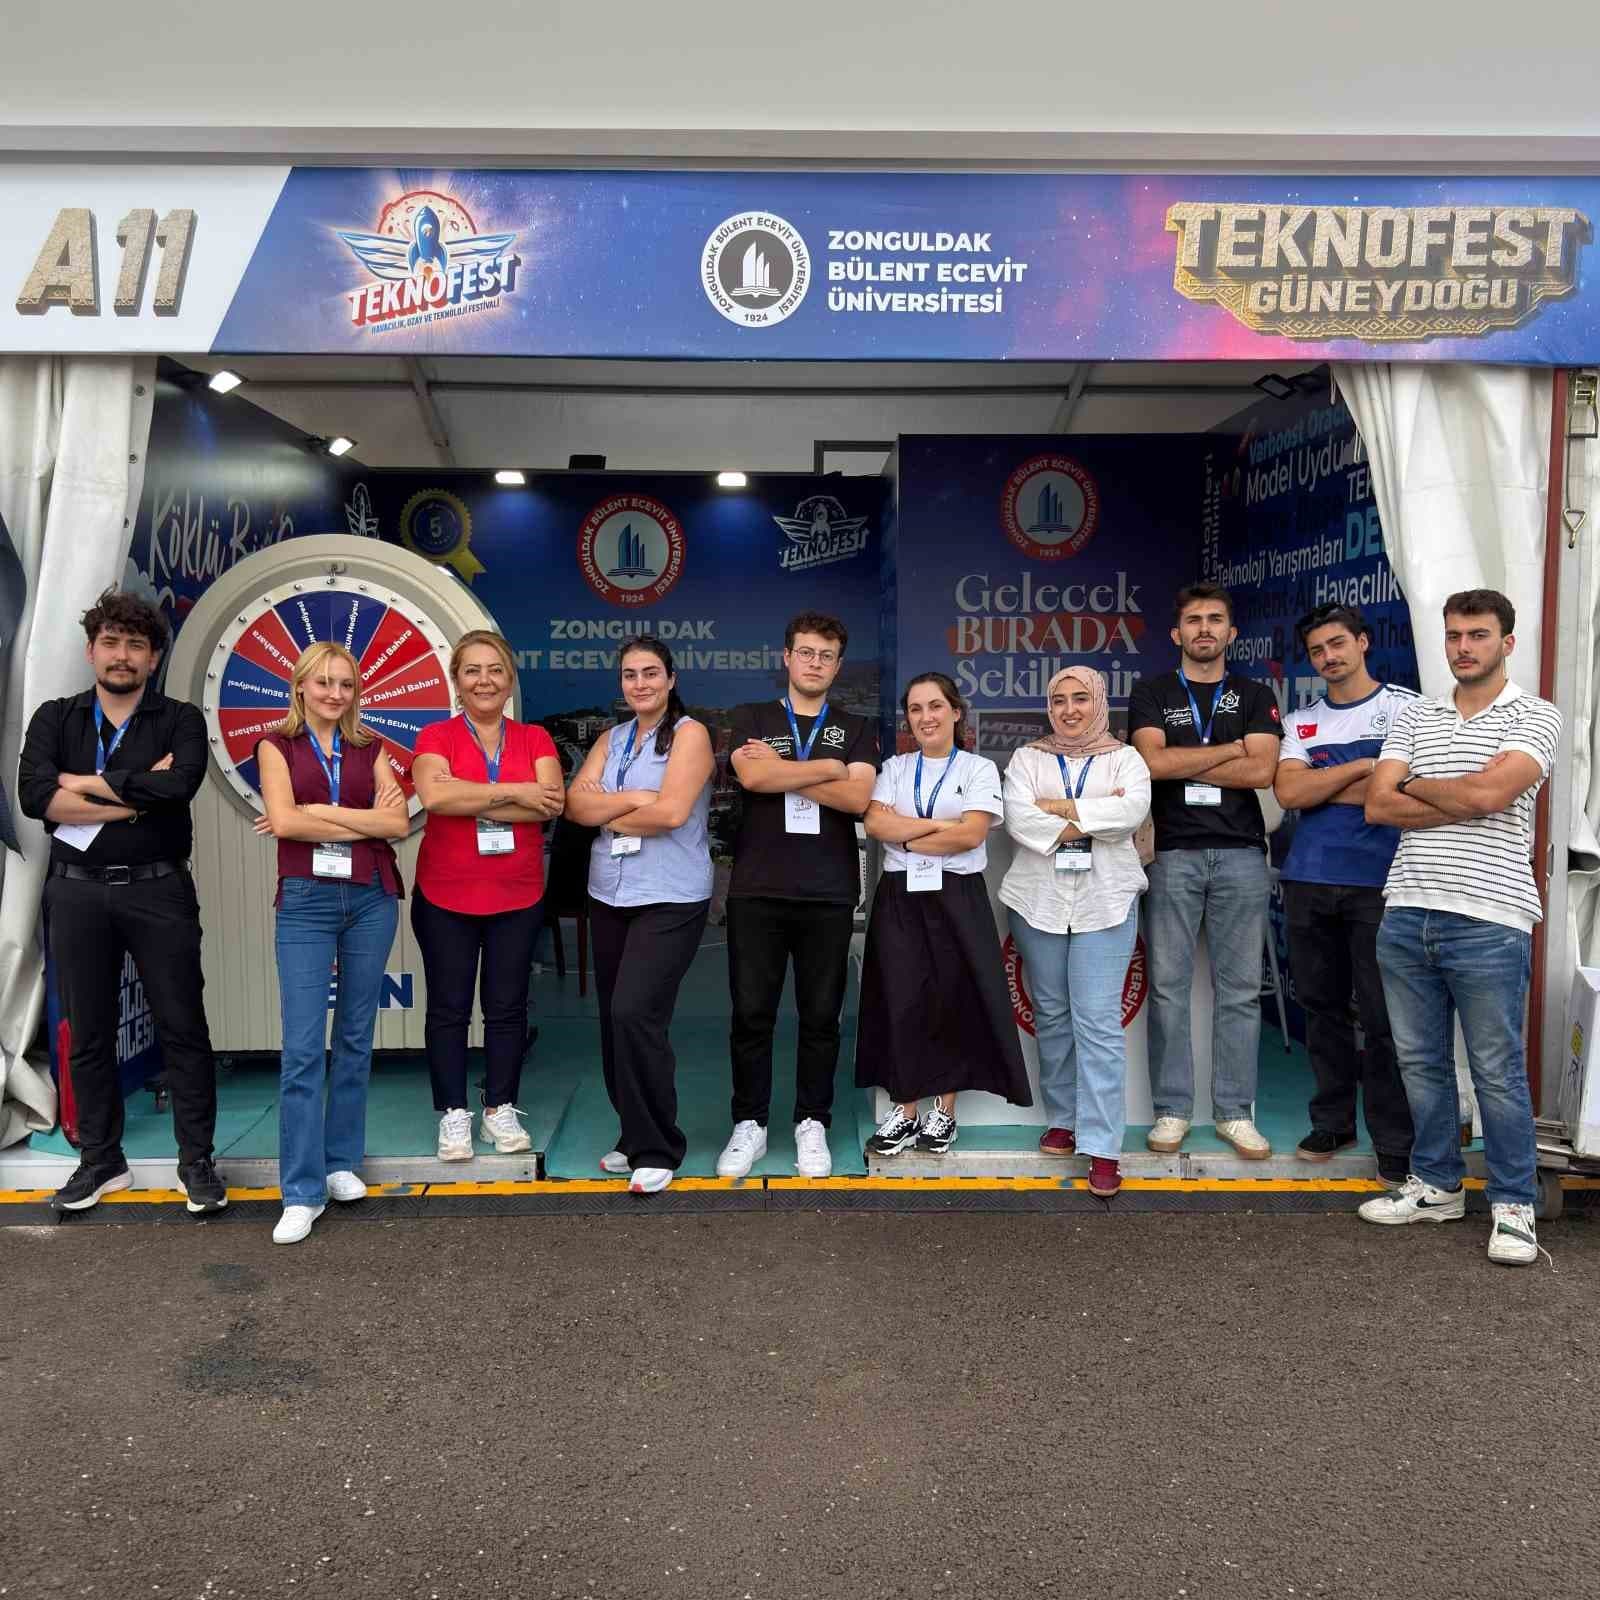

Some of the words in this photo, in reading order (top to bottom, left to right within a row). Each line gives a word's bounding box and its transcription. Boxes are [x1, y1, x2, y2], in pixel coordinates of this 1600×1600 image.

[715, 217, 753, 244] BÜLENT
[756, 217, 794, 241] ECEVİT
[828, 230, 993, 253] ZONGULDAK
[1170, 206, 1579, 271] TEKNOFEST
[15, 207, 198, 317] A11
[706, 244, 734, 313] ZONGULDAK
[778, 240, 807, 316] ÜNİVERSİTESİ
[828, 256, 930, 282] BÜLENT
[936, 256, 1028, 283] ECEVİT
[348, 253, 522, 326] TEKNOFEST
[828, 286, 1003, 313] ÜNİVERSİTESİ
[1251, 274, 1519, 314] GÜNEYDOĞU
[744, 313, 769, 322] 1924
[1245, 451, 1294, 507] Model
[592, 498, 629, 526] BÜLENT
[631, 498, 669, 521] ECEVİT
[149, 487, 227, 583] Köklü
[582, 523, 609, 593] ZONGULDAK
[655, 520, 682, 594] ÜNİVERSİTESİ
[1215, 546, 1266, 590] Teknoloji
[1268, 533, 1344, 583] Yarışmaları
[955, 571, 1142, 613] Gelecek
[1314, 561, 1400, 608] Havacılık
[348, 600, 360, 631] Hediyesi
[550, 619, 715, 640] ZONGULDAK
[956, 615, 1141, 654] BURADA
[361, 652, 388, 681] Dahaki
[386, 629, 413, 656] Bahara
[360, 695, 373, 706] Bir
[373, 686, 406, 703] Dahaki
[407, 677, 440, 692] Bahara
[360, 712, 386, 725] Sürpriz
[387, 719, 409, 730] BEUN
